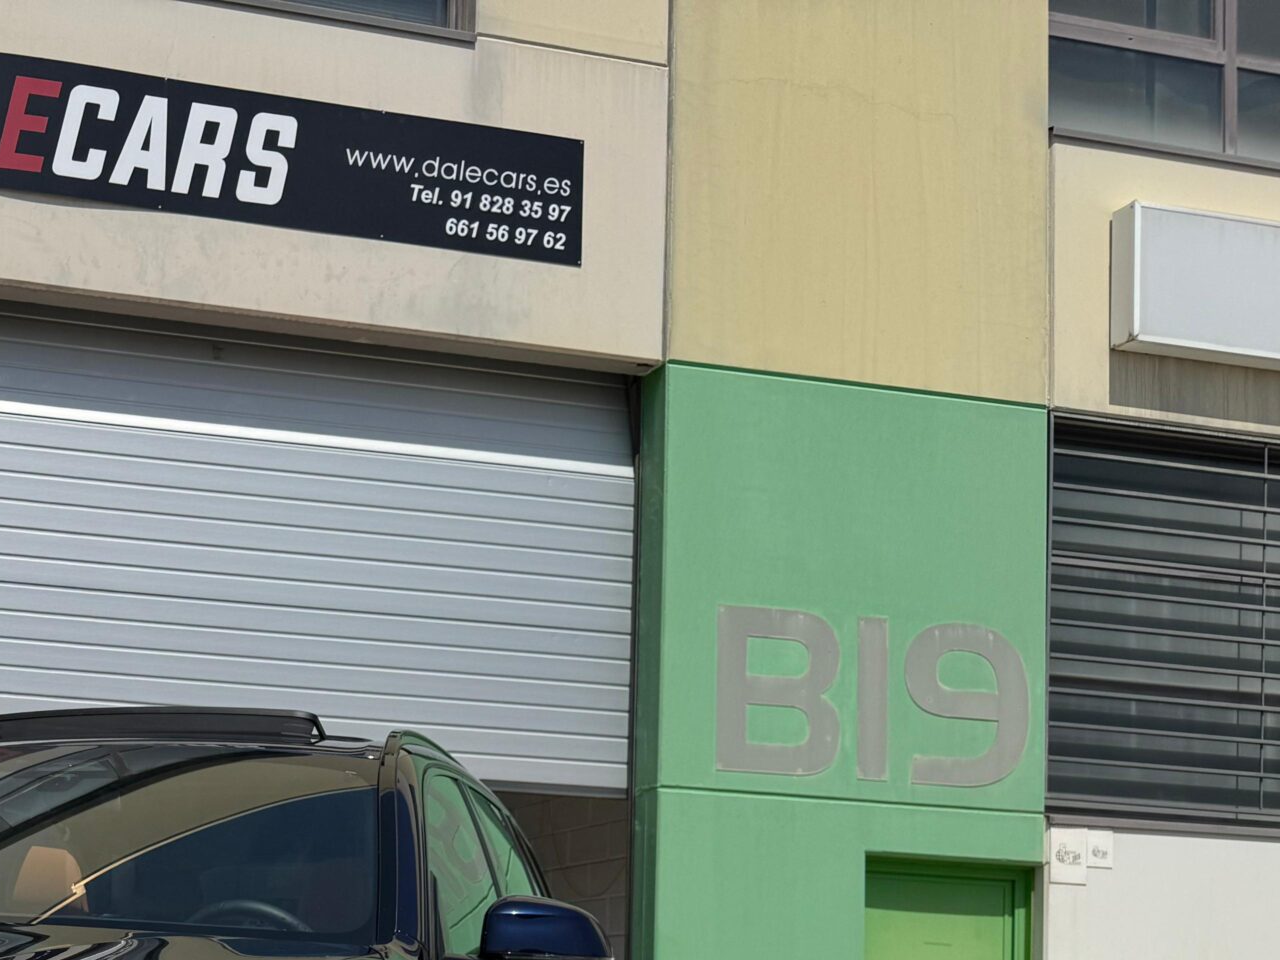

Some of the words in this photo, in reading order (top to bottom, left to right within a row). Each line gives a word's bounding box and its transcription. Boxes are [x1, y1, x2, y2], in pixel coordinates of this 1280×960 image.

[345, 148, 572, 197] www.dalecars.es
[409, 183, 443, 206] Tel.
[450, 189, 473, 209] 91
[479, 194, 515, 215] 828
[519, 199, 543, 219] 35
[548, 204, 572, 222] 97
[445, 217, 479, 239] 661
[485, 223, 510, 243] 56
[514, 227, 539, 246] 97
[543, 231, 568, 250] 62
[715, 603, 1030, 788] B19
